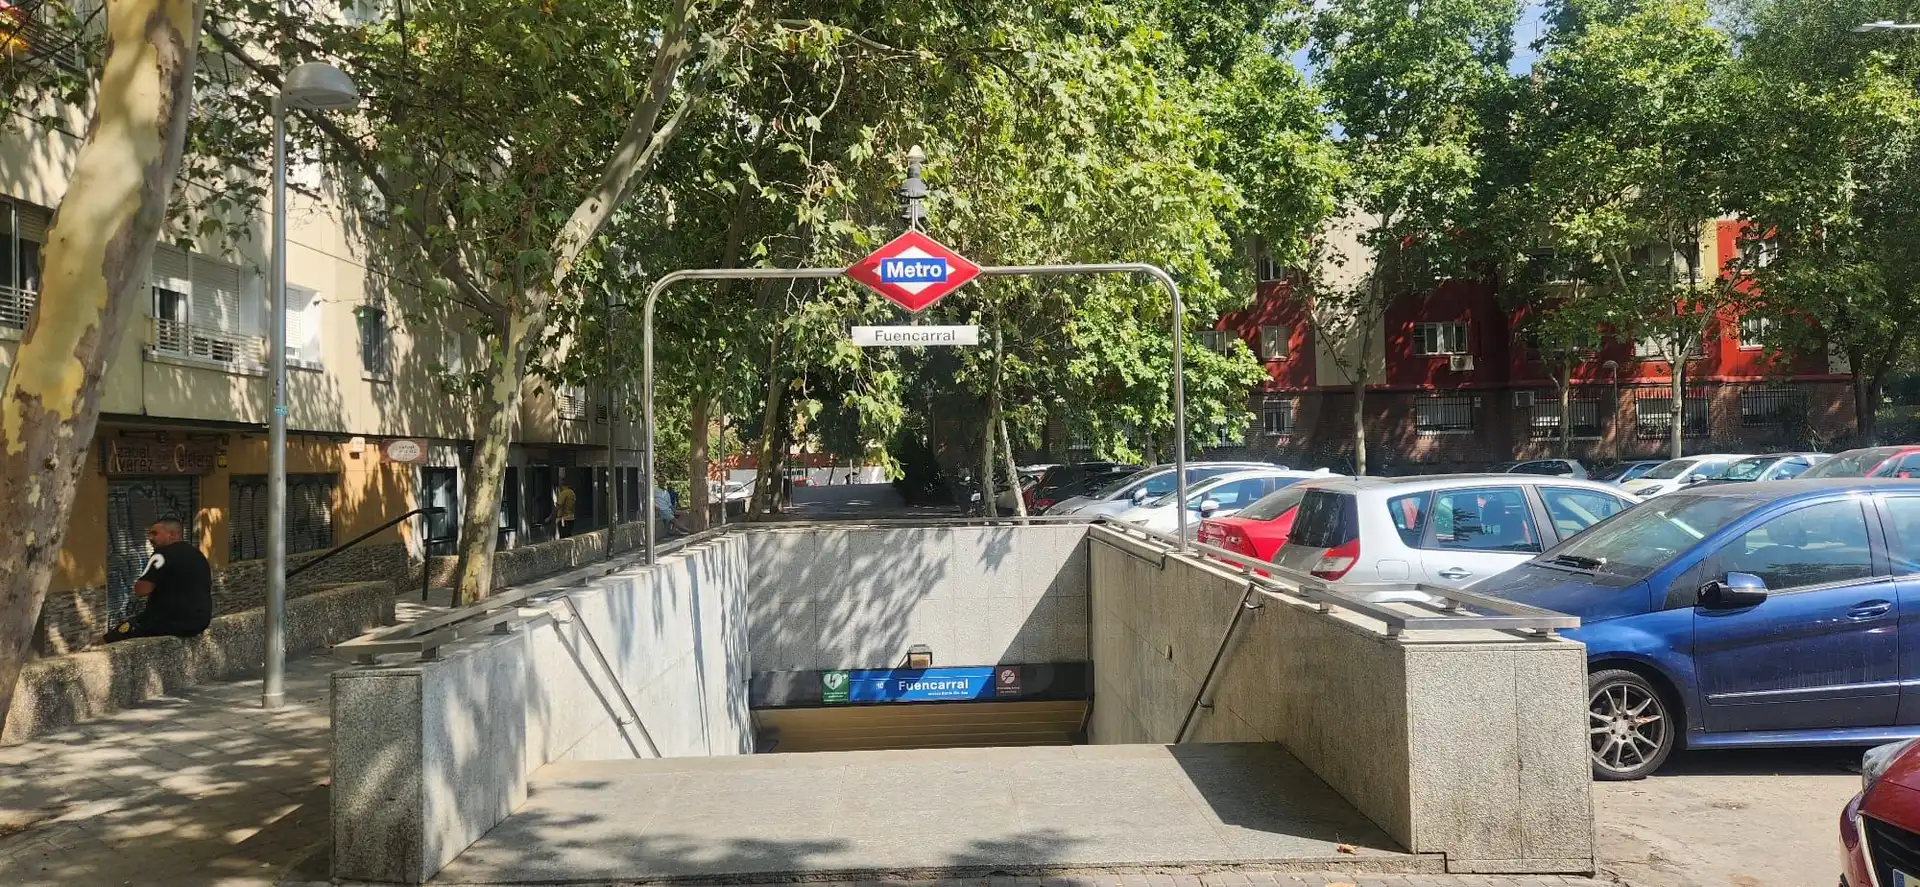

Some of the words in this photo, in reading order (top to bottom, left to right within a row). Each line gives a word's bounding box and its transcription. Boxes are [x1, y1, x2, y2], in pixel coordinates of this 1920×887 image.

[886, 261, 943, 278] Metro
[874, 329, 956, 342] Fuencarral
[898, 678, 969, 691] Fuencarral
